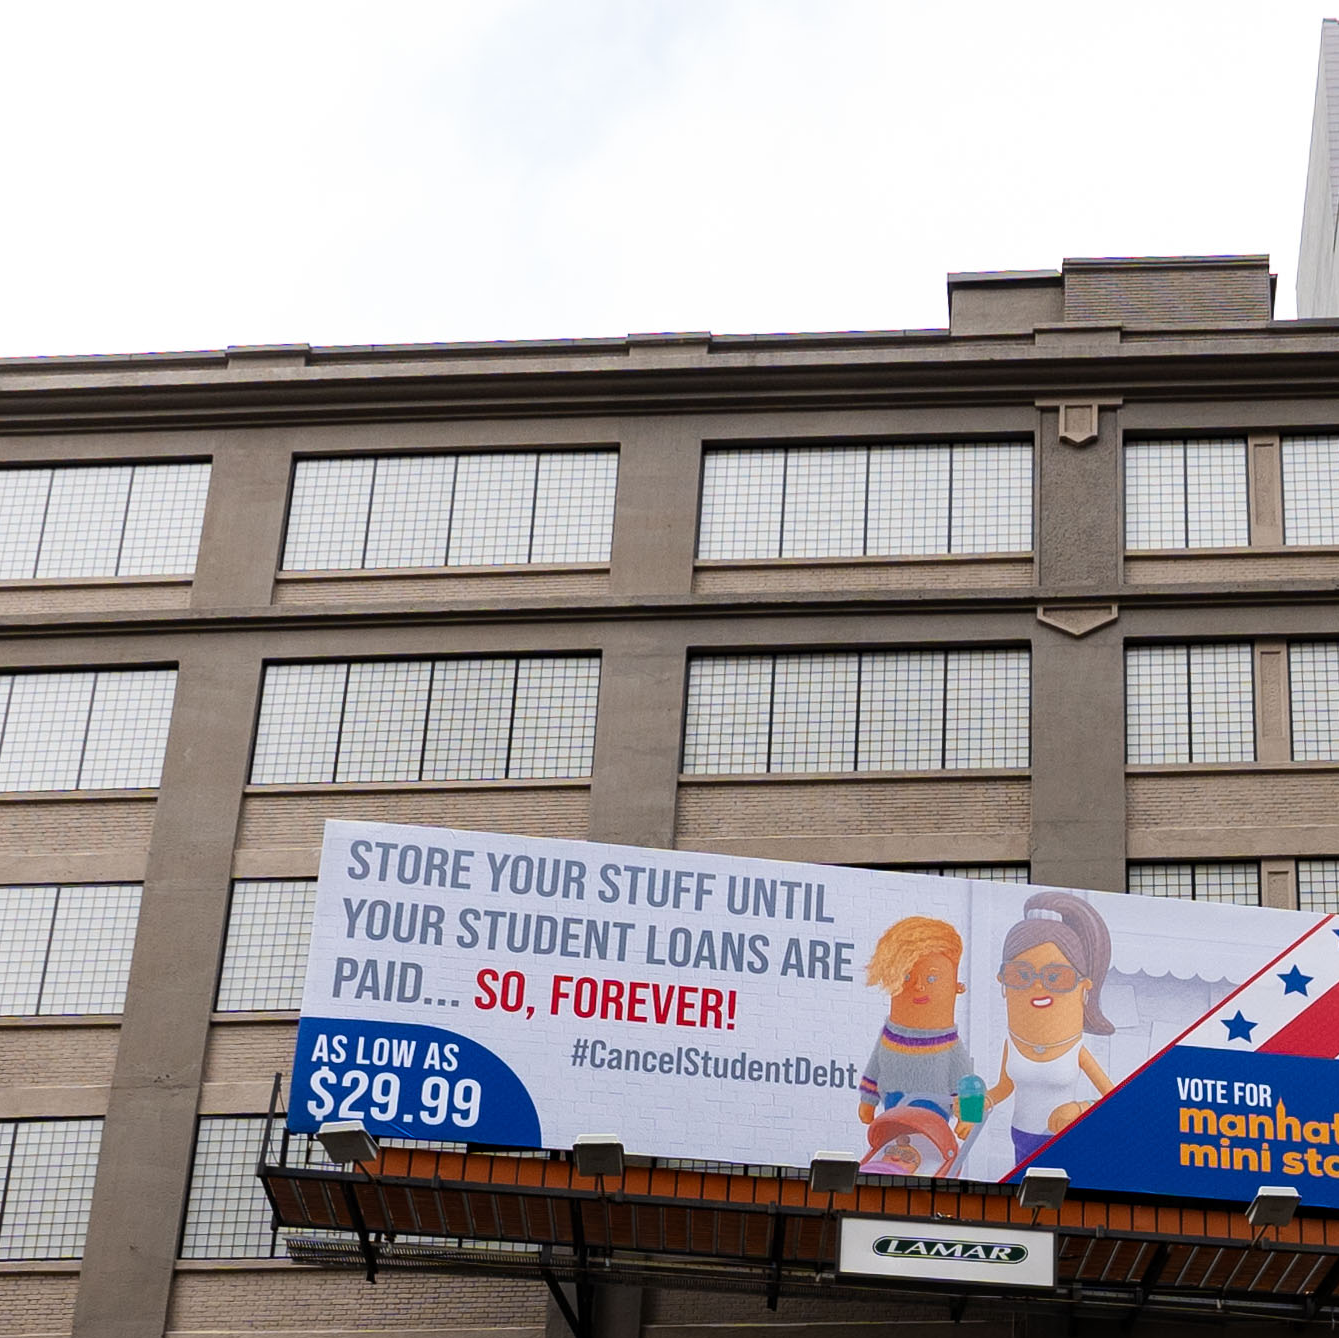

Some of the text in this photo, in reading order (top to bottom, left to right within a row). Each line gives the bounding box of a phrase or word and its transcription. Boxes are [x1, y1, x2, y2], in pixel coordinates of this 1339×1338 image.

[348, 840, 834, 924] STORE YOUR STUFF UNTIL
[342, 897, 855, 982] YOUR STUDENT LOANS ARE
[333, 957, 737, 1030] PAID... SO, FOREVER!
[311, 1034, 460, 1071] AS LOW AS
[571, 1038, 857, 1090] #CancelStudentDebt
[307, 1067, 482, 1128] $29.99
[1177, 1076, 1272, 1107] VOTE FOR
[1179, 1137, 1272, 1174] mini
[885, 1238, 1014, 1262] LAMAR
